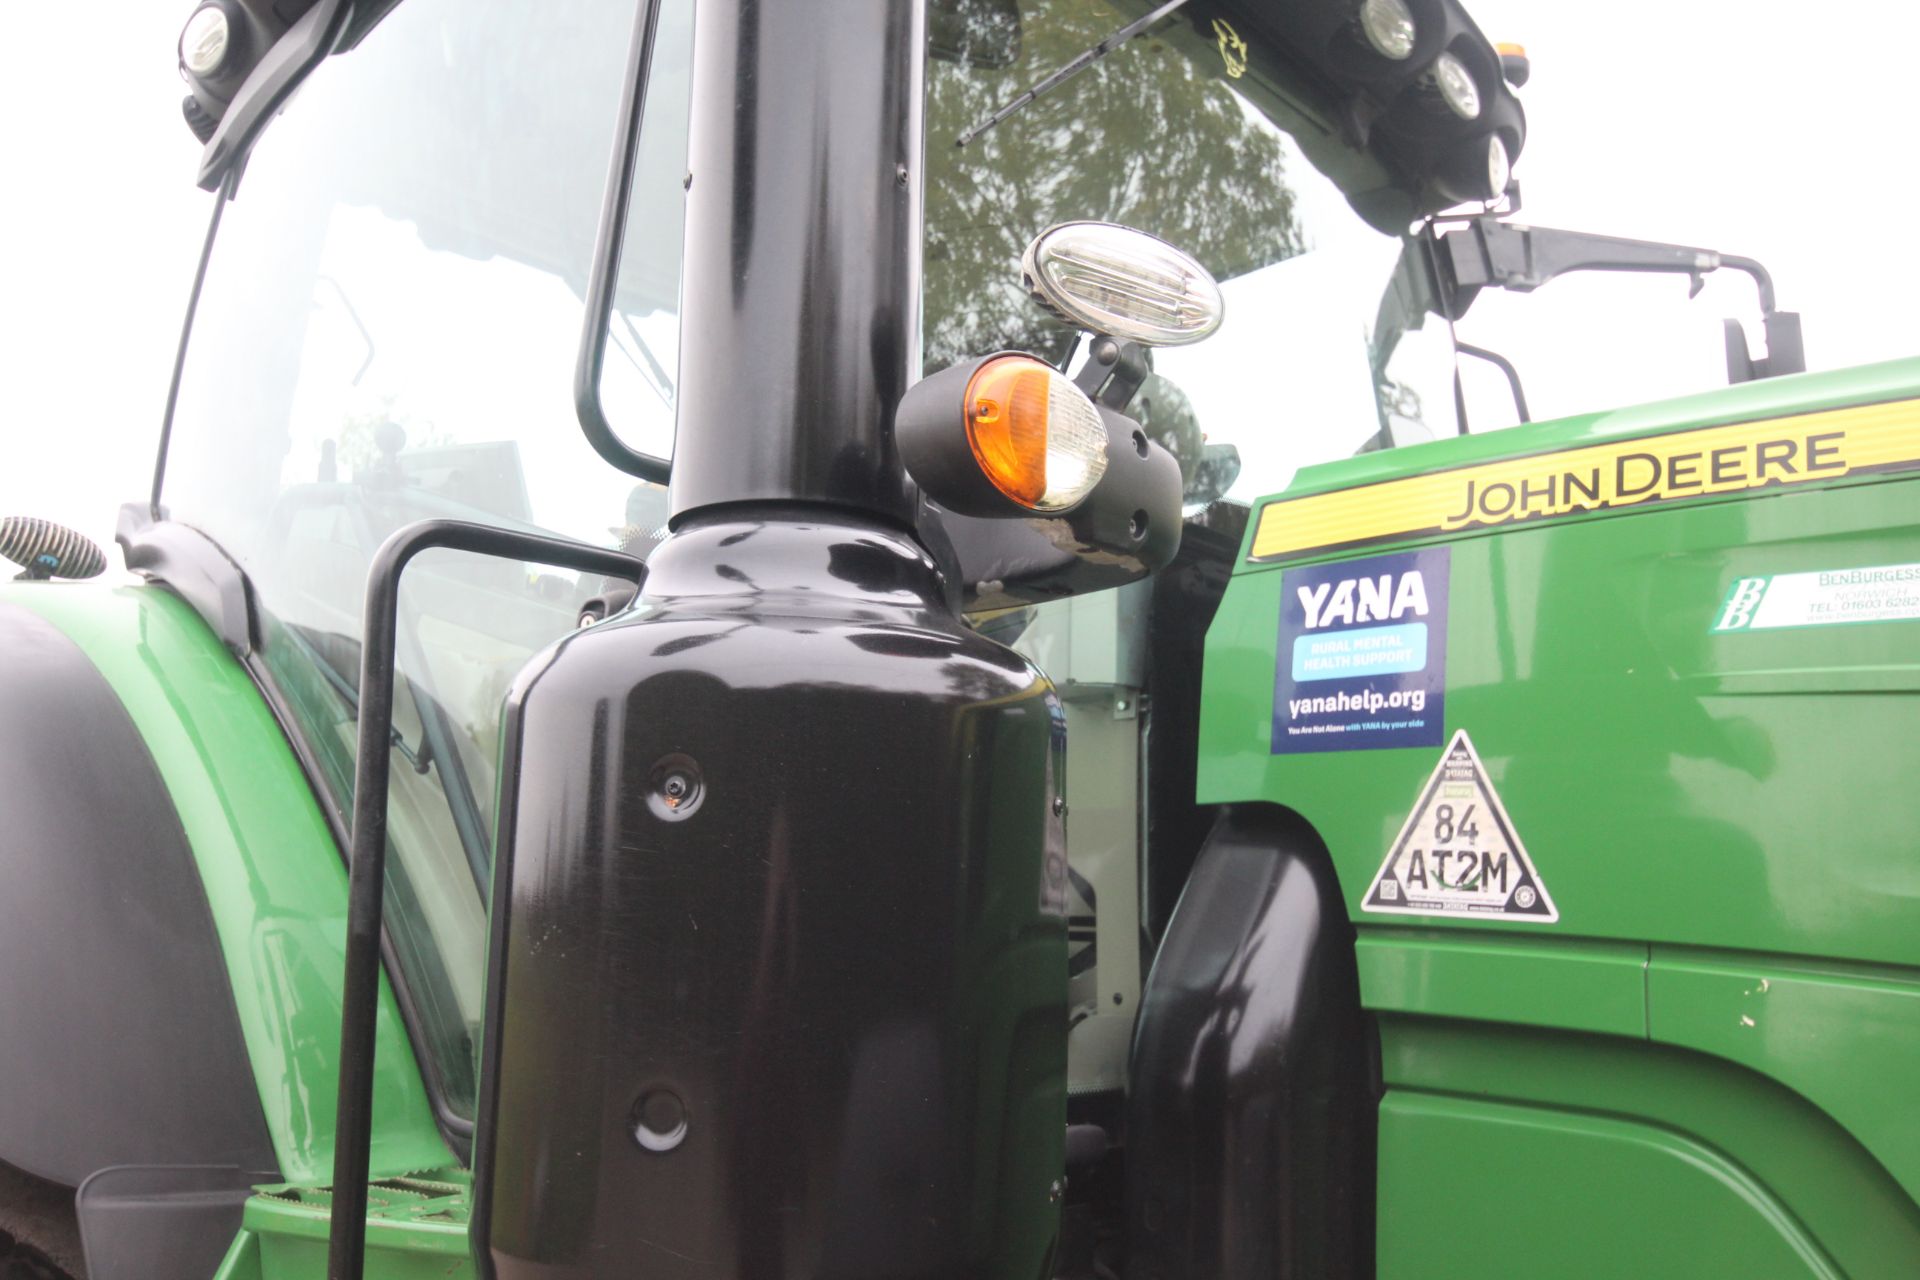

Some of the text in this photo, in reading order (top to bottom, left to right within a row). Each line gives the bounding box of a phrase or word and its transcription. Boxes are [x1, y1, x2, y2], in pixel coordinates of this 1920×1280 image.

[1447, 431, 1847, 523] JOHN DEERE
[1297, 570, 1429, 629] YANA
[1841, 598, 1881, 611] 01603
[1304, 648, 1413, 671] HEALTH SUPPORT
[1311, 634, 1403, 655] RURAL MENTAL
[1289, 688, 1425, 720] yanahelp.org
[1288, 726, 1300, 735] You
[1300, 725, 1312, 734] Are
[1312, 725, 1325, 734] Not
[1325, 723, 1345, 734] Alone
[1345, 722, 1361, 732] with
[1361, 721, 1380, 731] YANA
[1391, 720, 1408, 731] your
[1434, 804, 1479, 845] 84
[1406, 849, 1507, 894] AT2M
